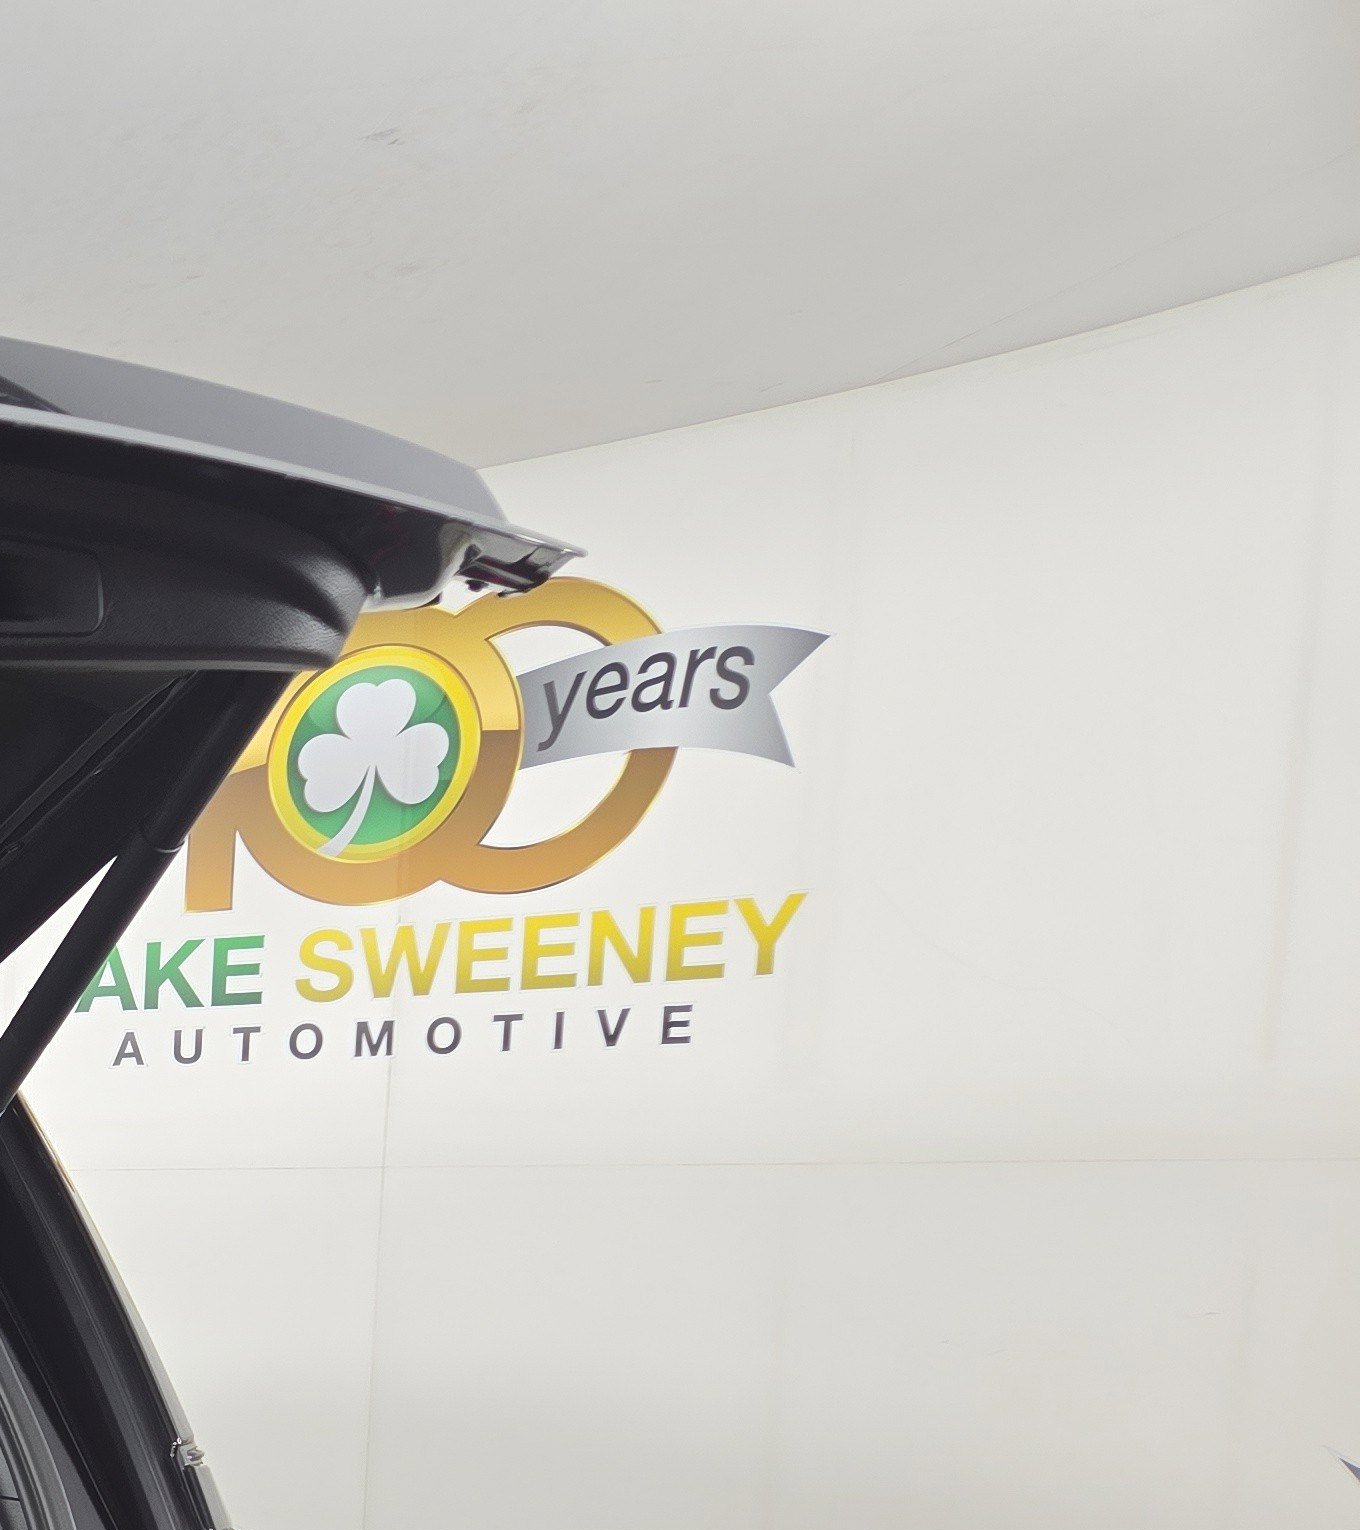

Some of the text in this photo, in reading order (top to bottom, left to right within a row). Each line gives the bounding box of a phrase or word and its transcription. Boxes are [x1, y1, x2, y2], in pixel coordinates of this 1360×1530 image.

[536, 645, 755, 752] years
[76, 893, 807, 1013] AKE SWEENEY
[112, 1004, 693, 1067] AUTOMOTIVE
